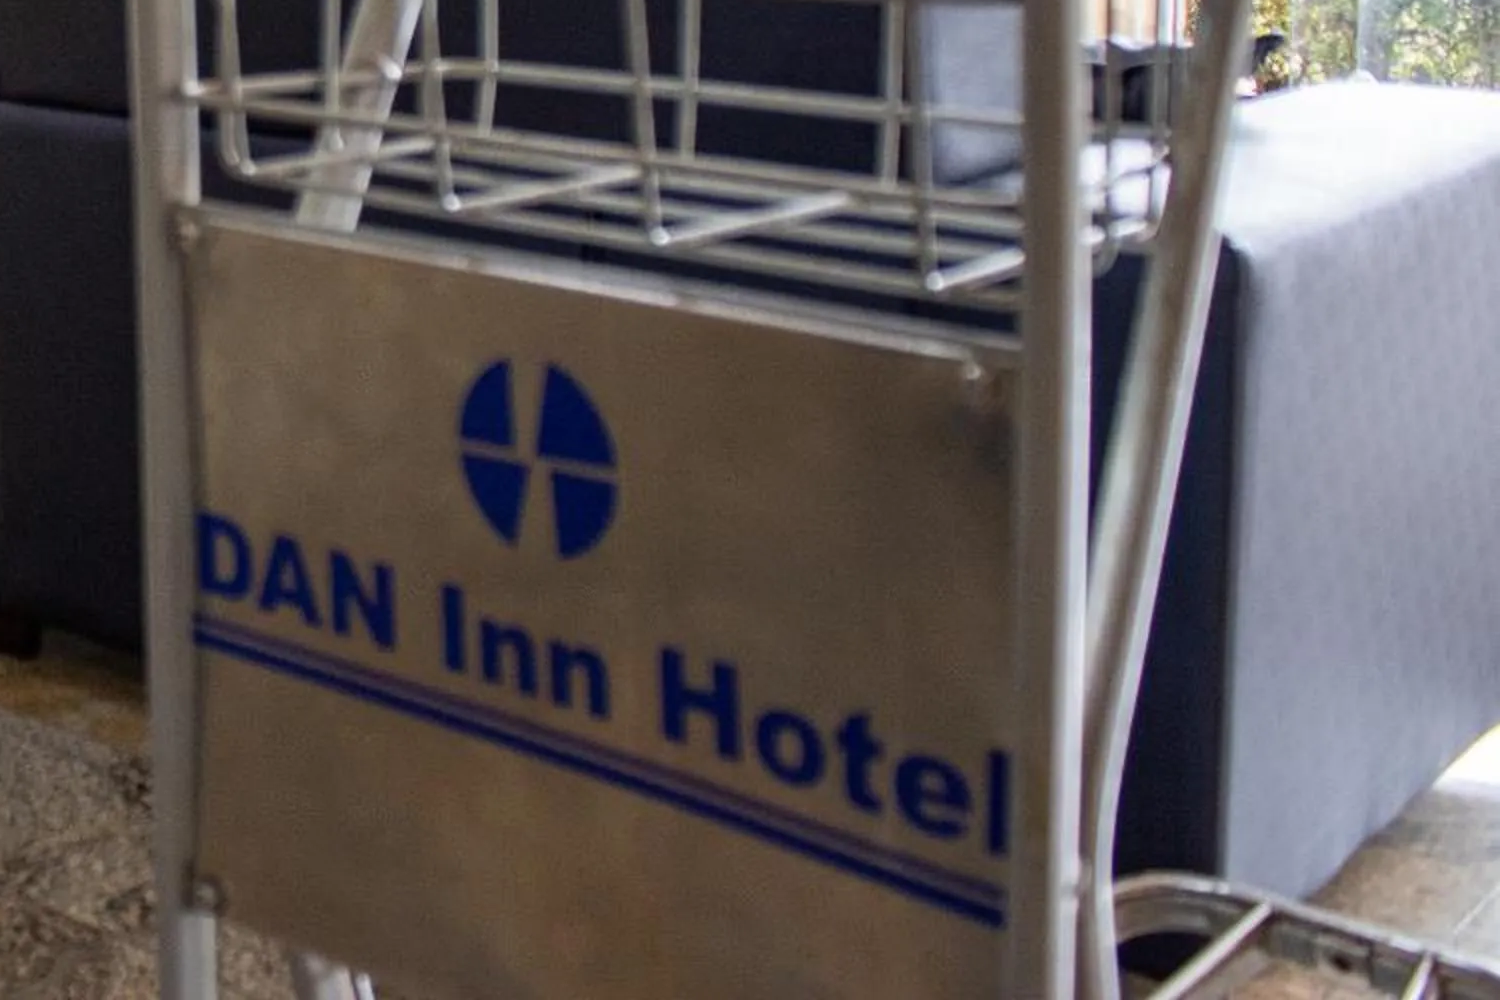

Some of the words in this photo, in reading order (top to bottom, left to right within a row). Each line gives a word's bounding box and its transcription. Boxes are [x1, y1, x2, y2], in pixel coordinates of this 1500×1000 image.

[195, 511, 396, 652] DAN
[439, 581, 613, 723] Inn
[657, 644, 1011, 857] Hotel
